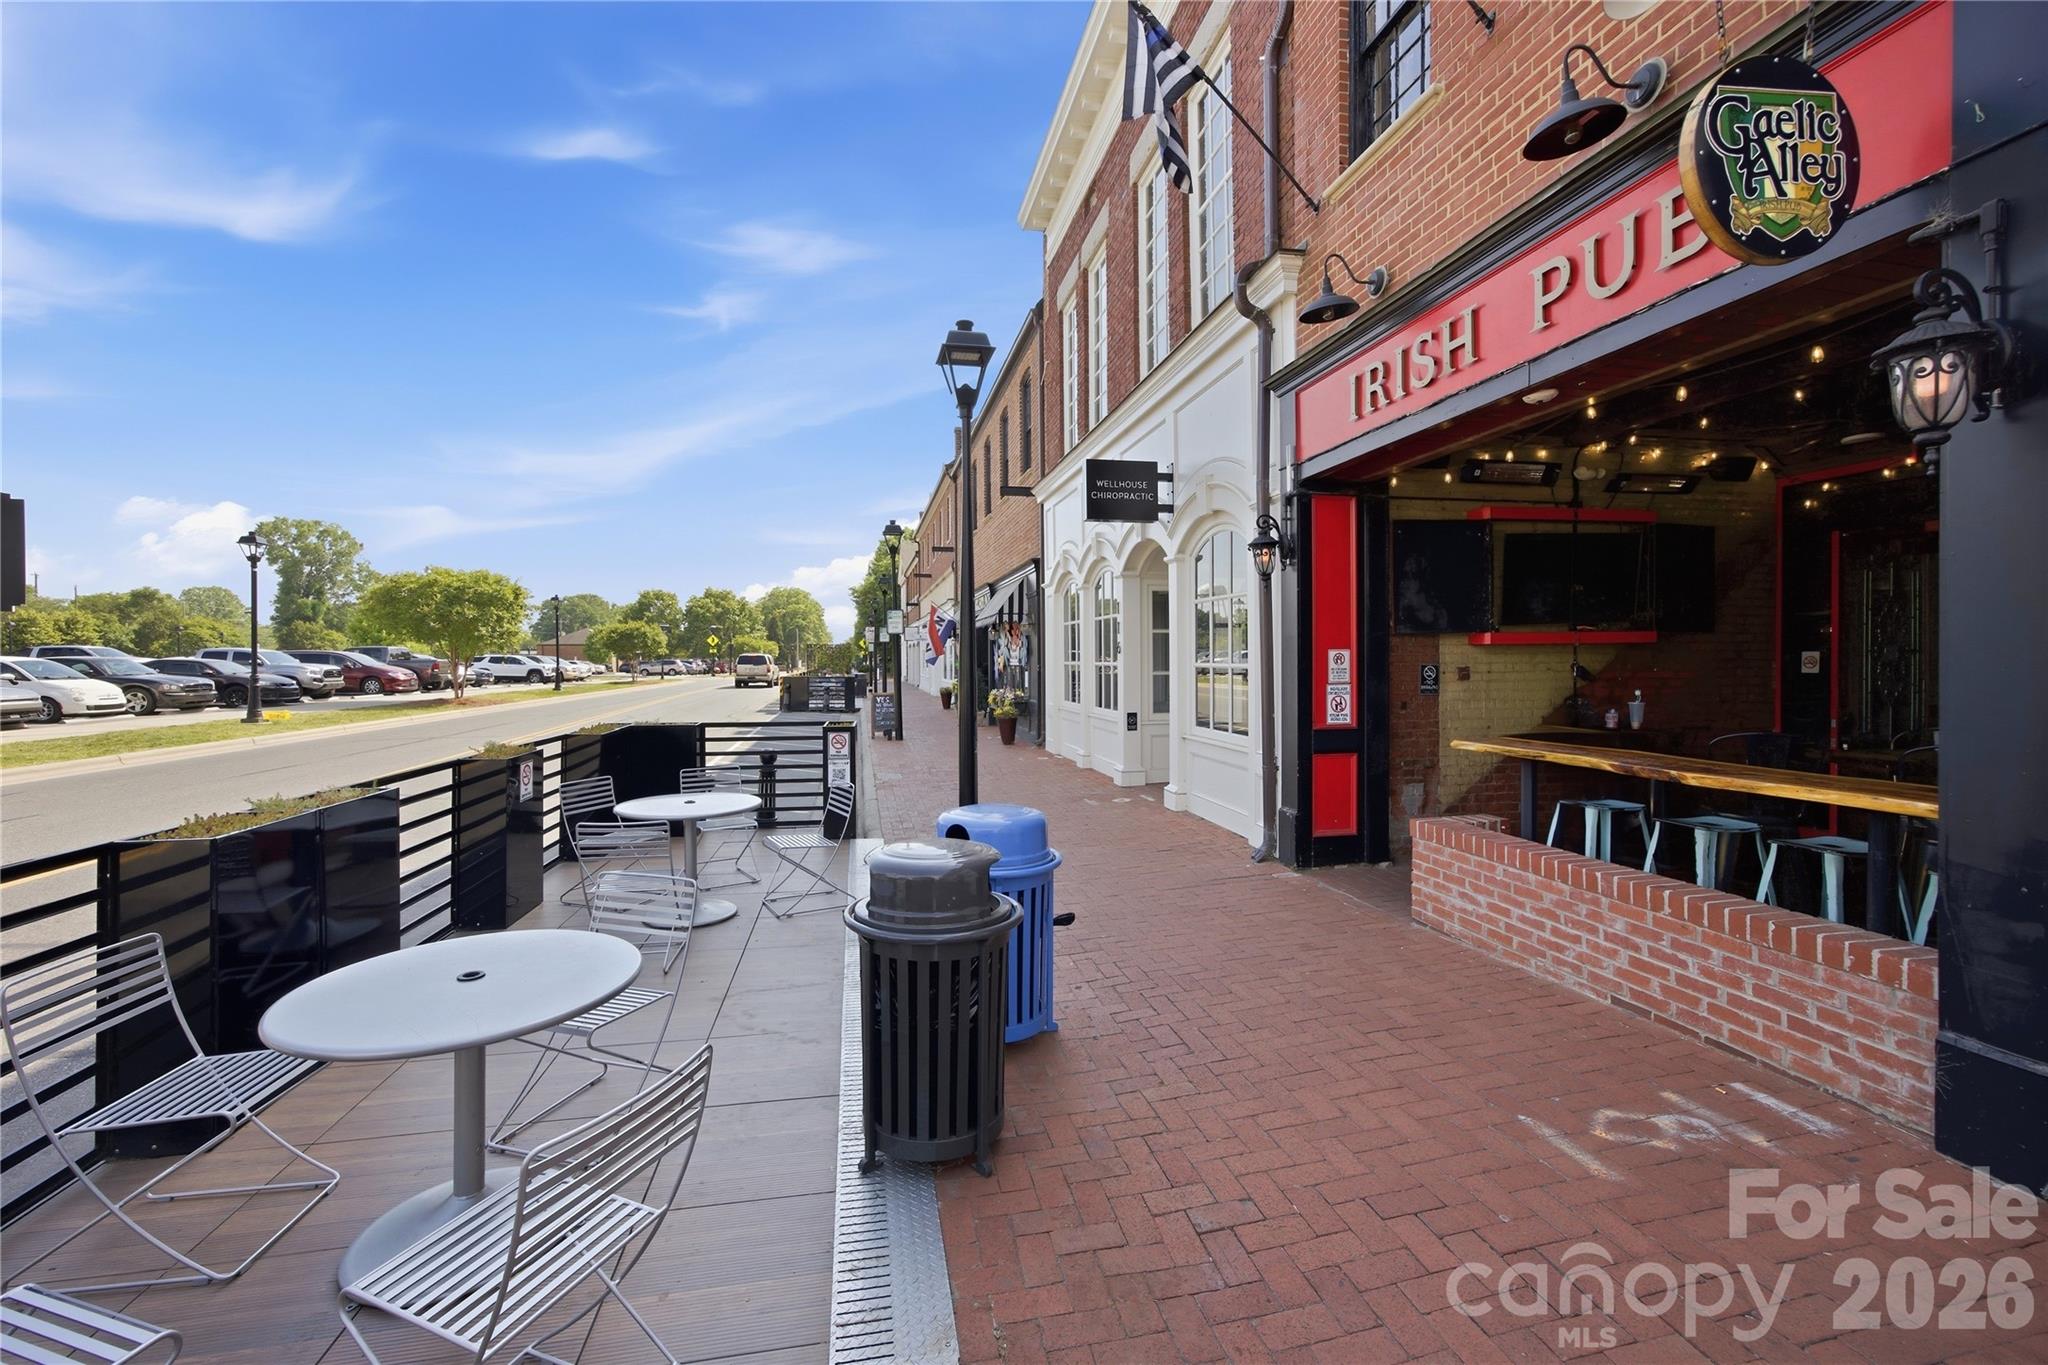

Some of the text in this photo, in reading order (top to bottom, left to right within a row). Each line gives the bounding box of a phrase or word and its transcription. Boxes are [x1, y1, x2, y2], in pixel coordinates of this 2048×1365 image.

[1705, 93, 1841, 156] Gaelic
[1738, 138, 1847, 200] Alley
[1348, 304, 1479, 422] IRISH
[1091, 491, 1154, 501] CHIROPRACTIC
[1096, 480, 1148, 489] WELLHOUSE
